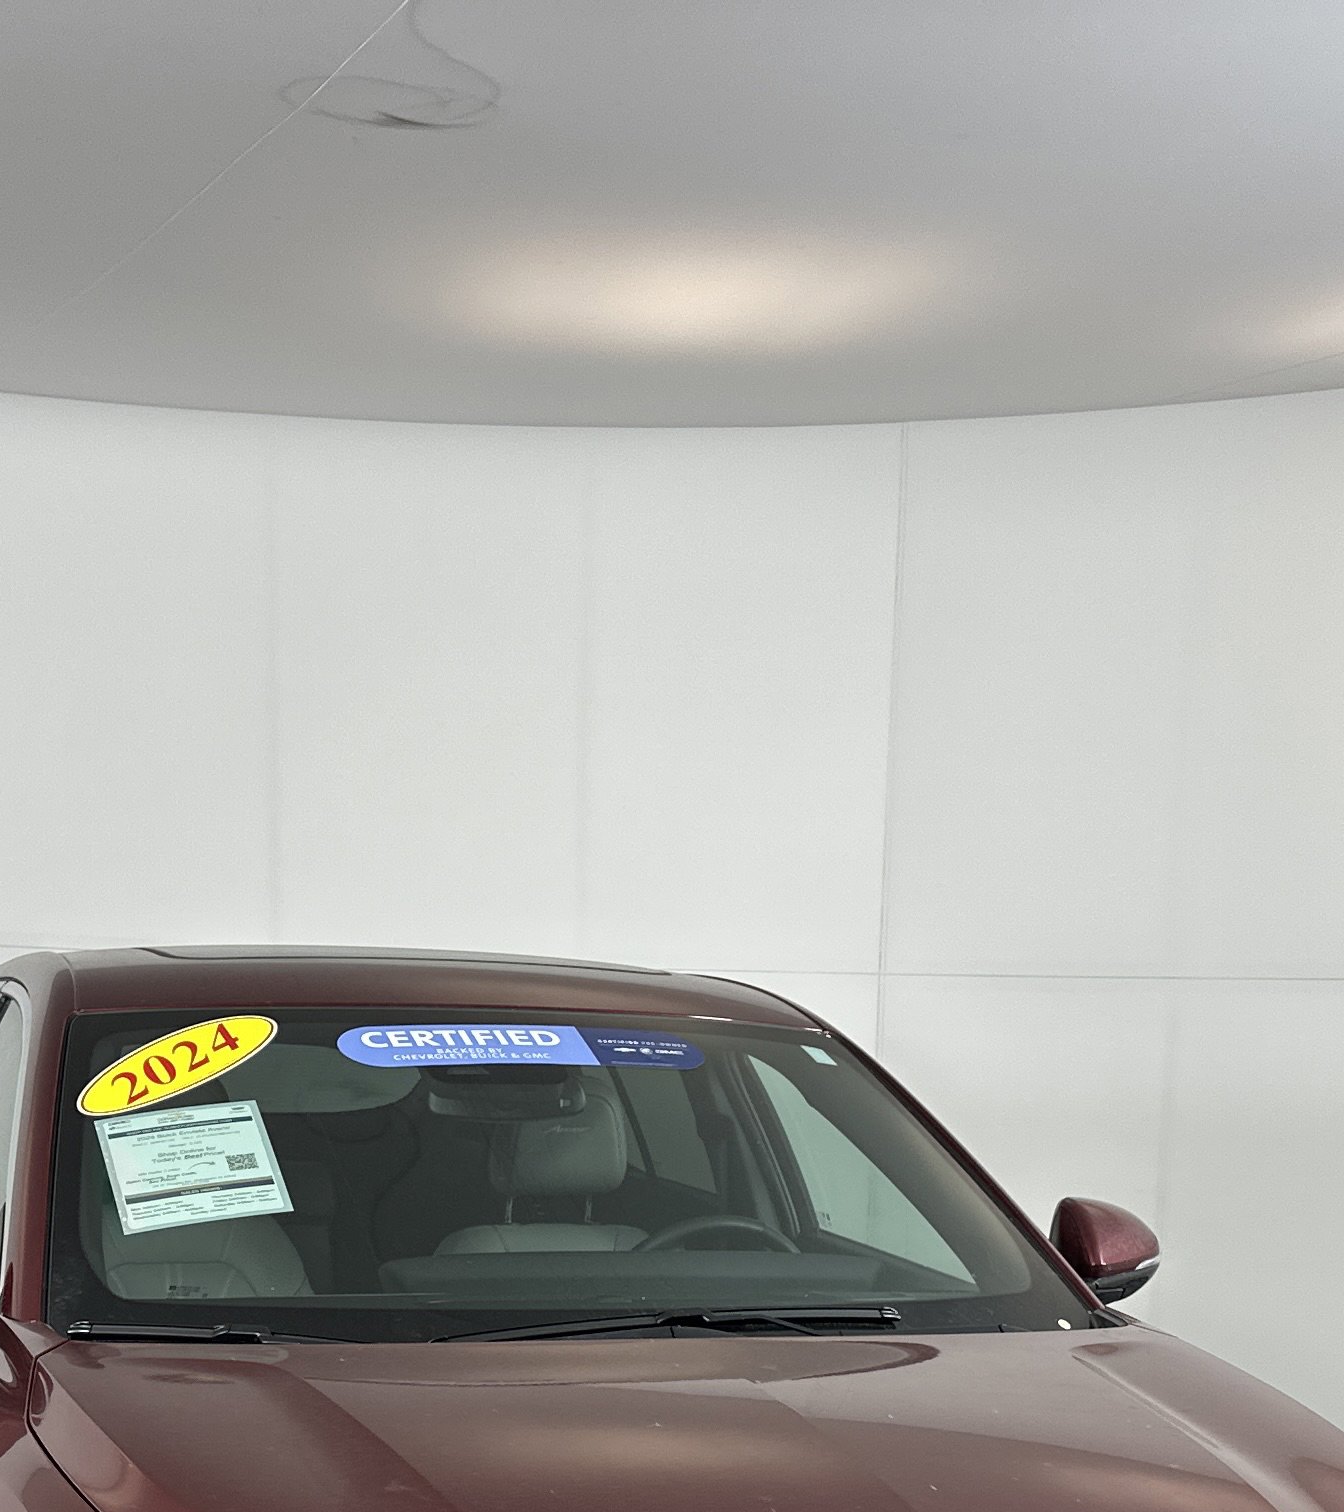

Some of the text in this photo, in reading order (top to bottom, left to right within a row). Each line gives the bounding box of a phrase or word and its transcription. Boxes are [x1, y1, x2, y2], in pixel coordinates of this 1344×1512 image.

[360, 1029, 561, 1049] CERTIFIED
[110, 1023, 240, 1105] 2024
[393, 1053, 468, 1061] CHEVROLET,
